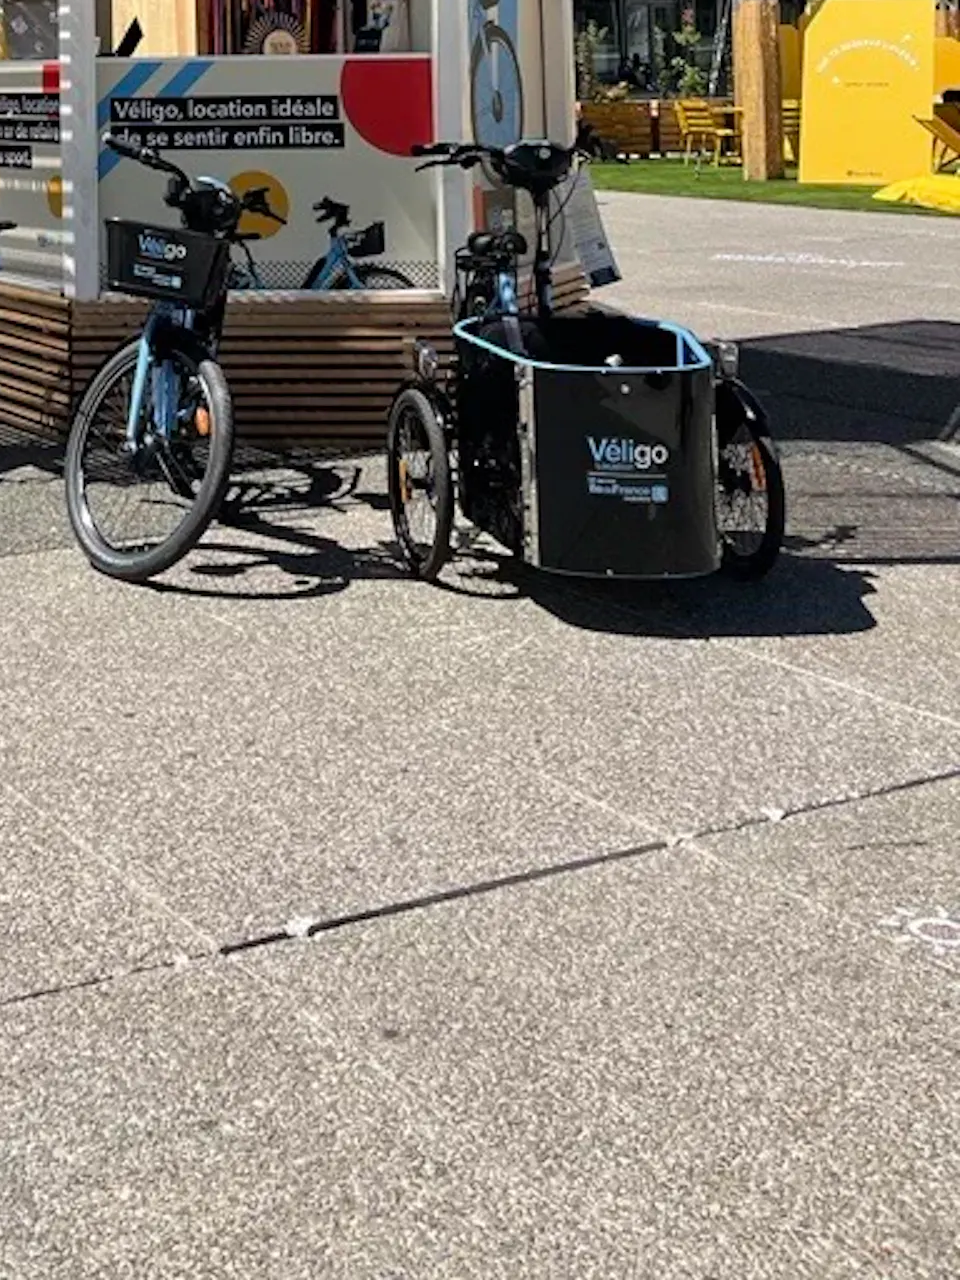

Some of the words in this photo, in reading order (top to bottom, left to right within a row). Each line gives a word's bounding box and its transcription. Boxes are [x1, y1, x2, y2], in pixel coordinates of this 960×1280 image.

[114, 100, 184, 122] Véligo,
[189, 99, 267, 117] location
[272, 97, 334, 116] idéale
[118, 128, 141, 144] de
[146, 131, 169, 146] se
[173, 127, 227, 146] sentir
[233, 126, 284, 145] enfin
[289, 126, 340, 145] libre.
[138, 234, 186, 260] Véligo
[586, 436, 668, 469] Véligo
